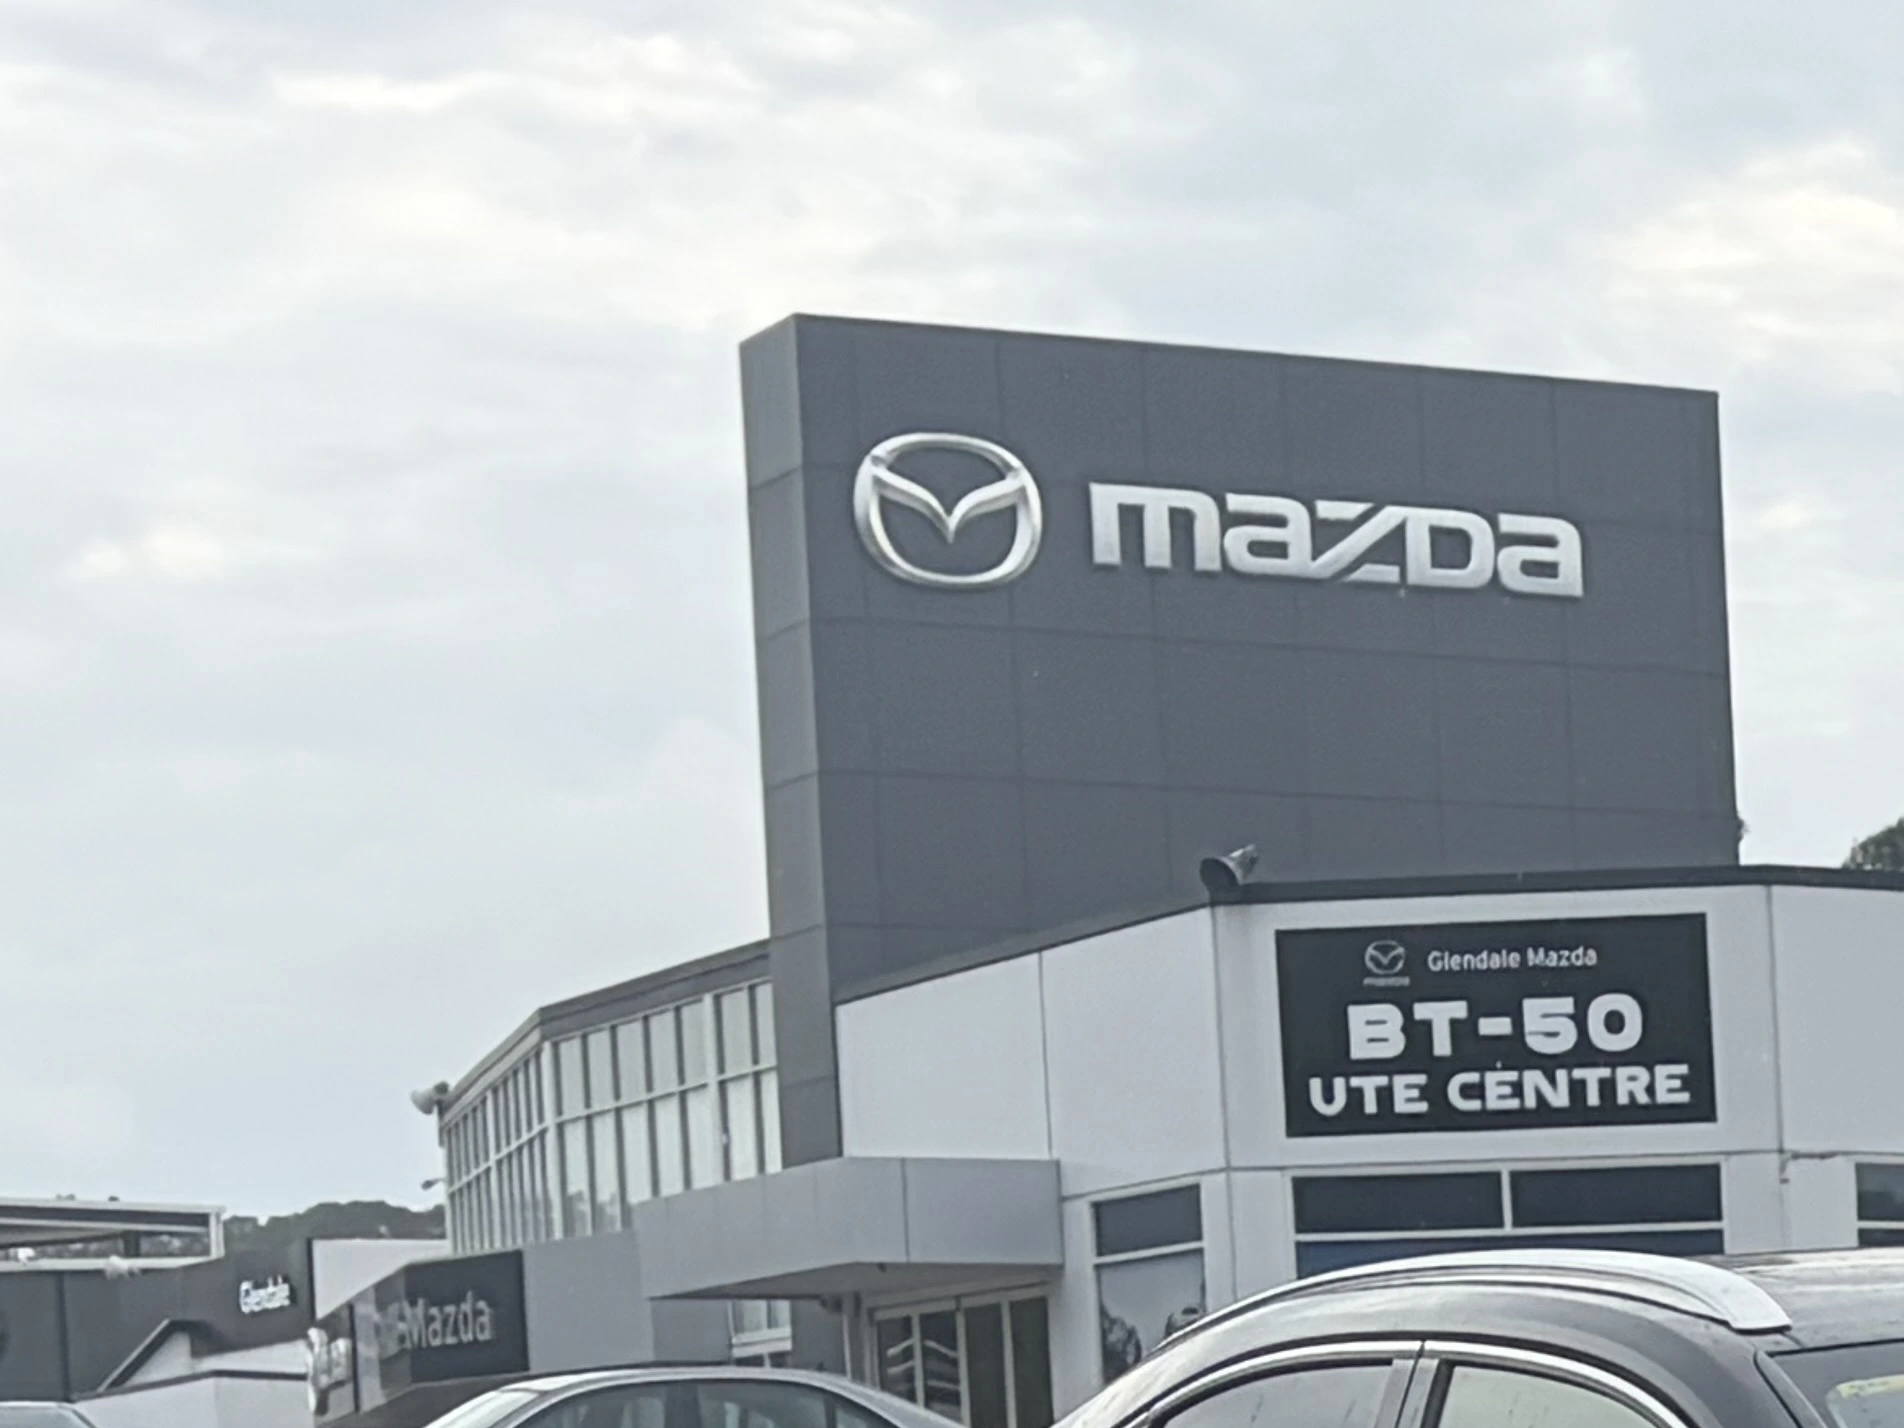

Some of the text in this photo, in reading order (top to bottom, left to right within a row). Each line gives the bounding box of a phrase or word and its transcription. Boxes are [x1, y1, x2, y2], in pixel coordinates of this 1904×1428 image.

[1088, 481, 1584, 599] mazda
[1426, 945, 1599, 972] Glendale Mazda
[1346, 992, 1644, 1060] BT-50
[1309, 1063, 1691, 1117] UTE CENTRE
[402, 1289, 494, 1350] Mazda
